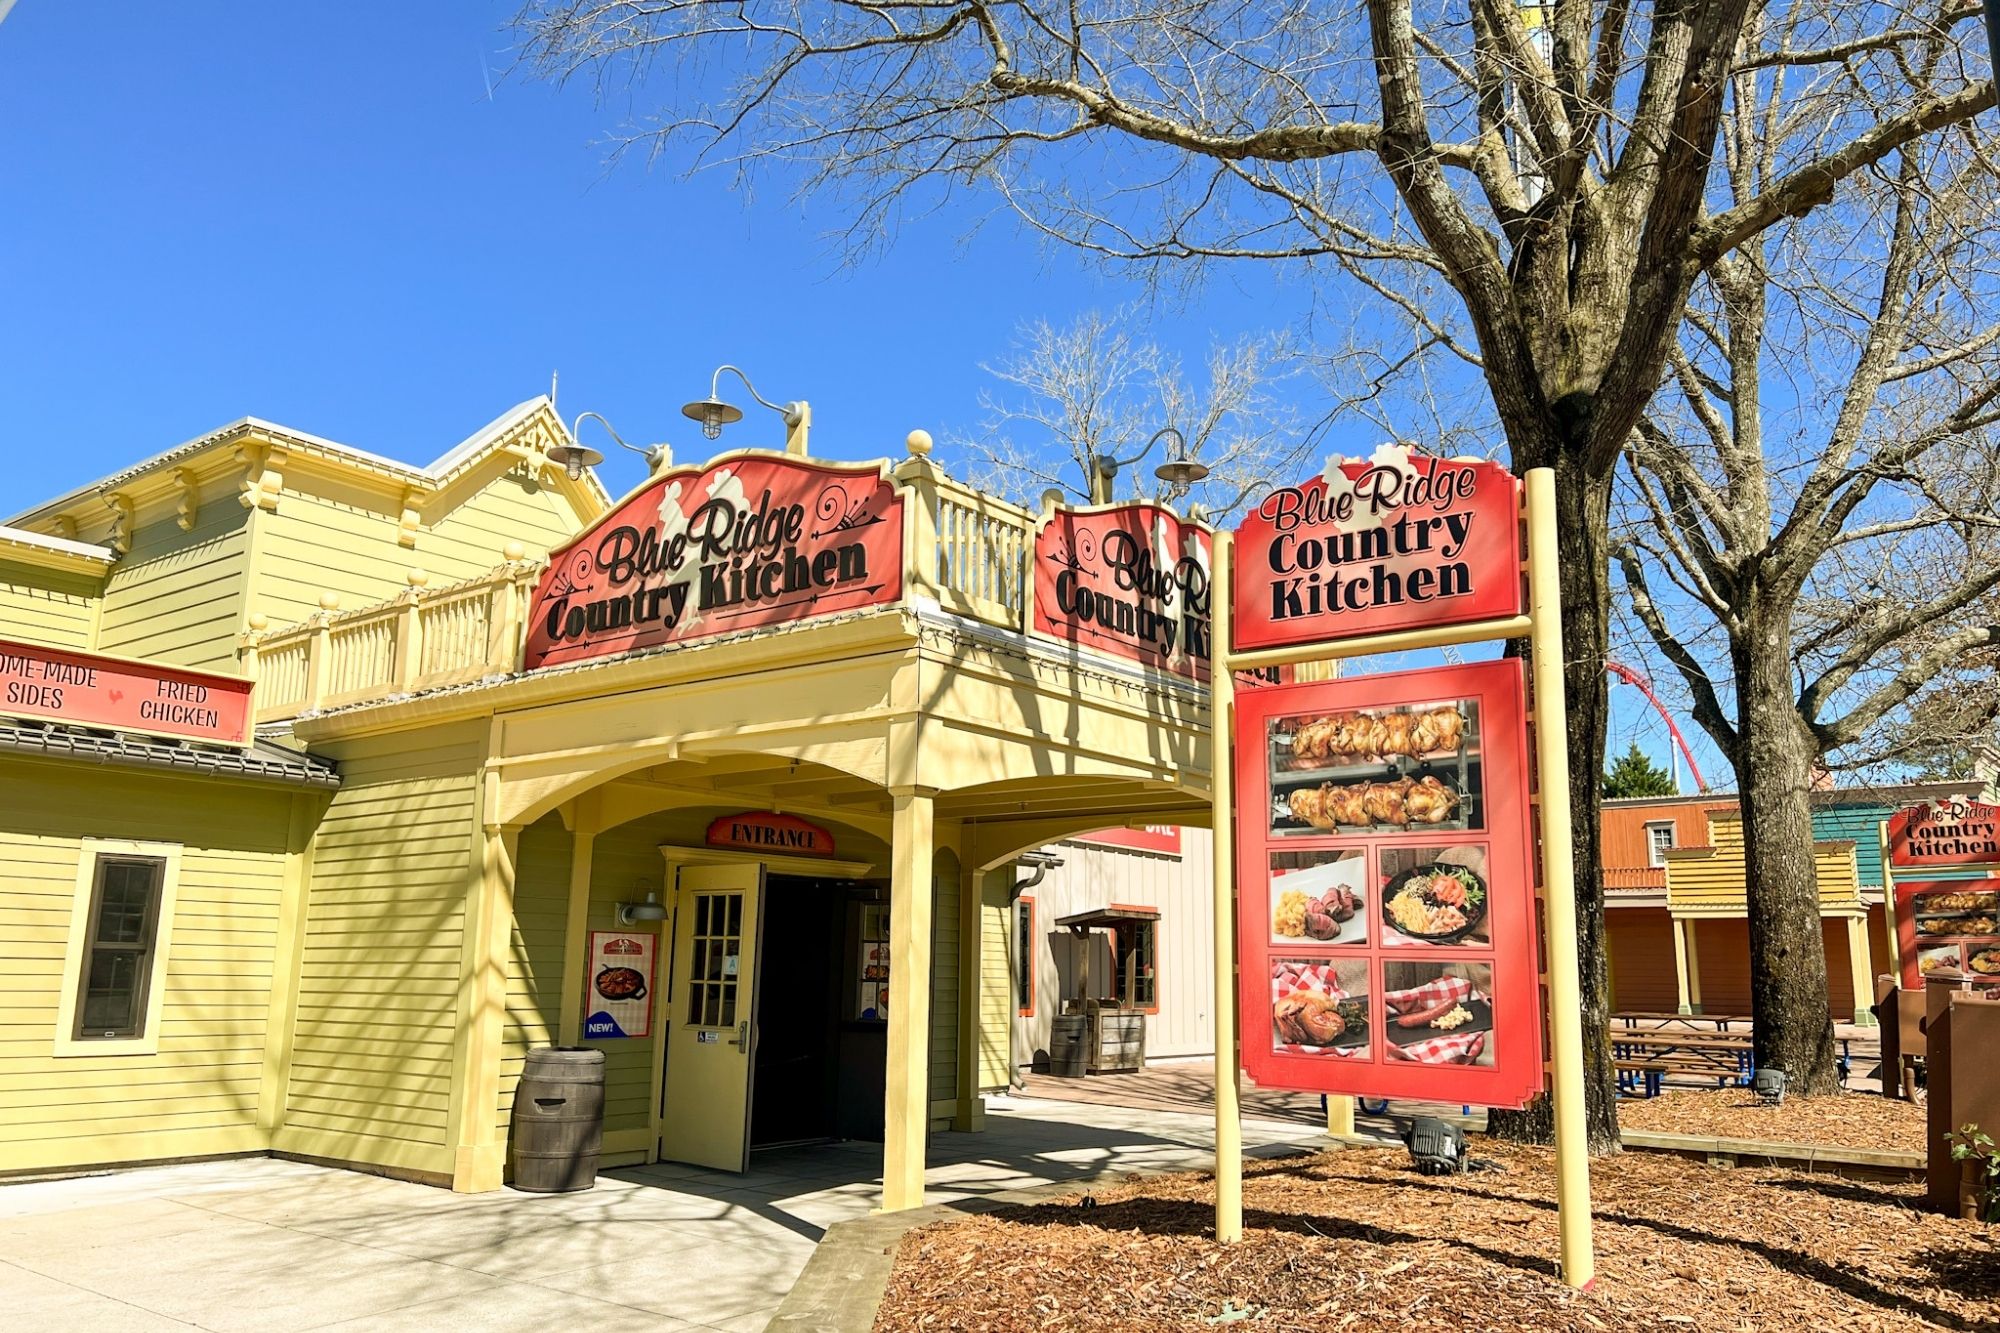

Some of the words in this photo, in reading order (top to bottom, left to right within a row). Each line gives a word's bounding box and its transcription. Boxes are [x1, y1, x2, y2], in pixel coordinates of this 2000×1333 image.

[1257, 487, 1355, 532] Blue
[1353, 459, 1475, 514] Ridge
[595, 525, 688, 585] Blue
[686, 488, 804, 564] Ridge
[1269, 511, 1474, 574] Country
[1102, 529, 1174, 606] Blue
[546, 579, 690, 642] Country
[697, 541, 868, 611] Kitchen
[1270, 562, 1472, 620] Kitchen
[1056, 569, 1179, 658] Country
[7, 681, 63, 709] SIDES
[157, 679, 207, 704] FRIED
[140, 700, 218, 729] CHICKEN
[1900, 806, 1944, 823] Blue
[1942, 801, 1995, 822] Ridge
[731, 823, 816, 849] ENTRANCE
[1906, 821, 1995, 840] Country
[1908, 838, 1997, 857] Kitchen
[588, 1023, 614, 1033] NEW!
